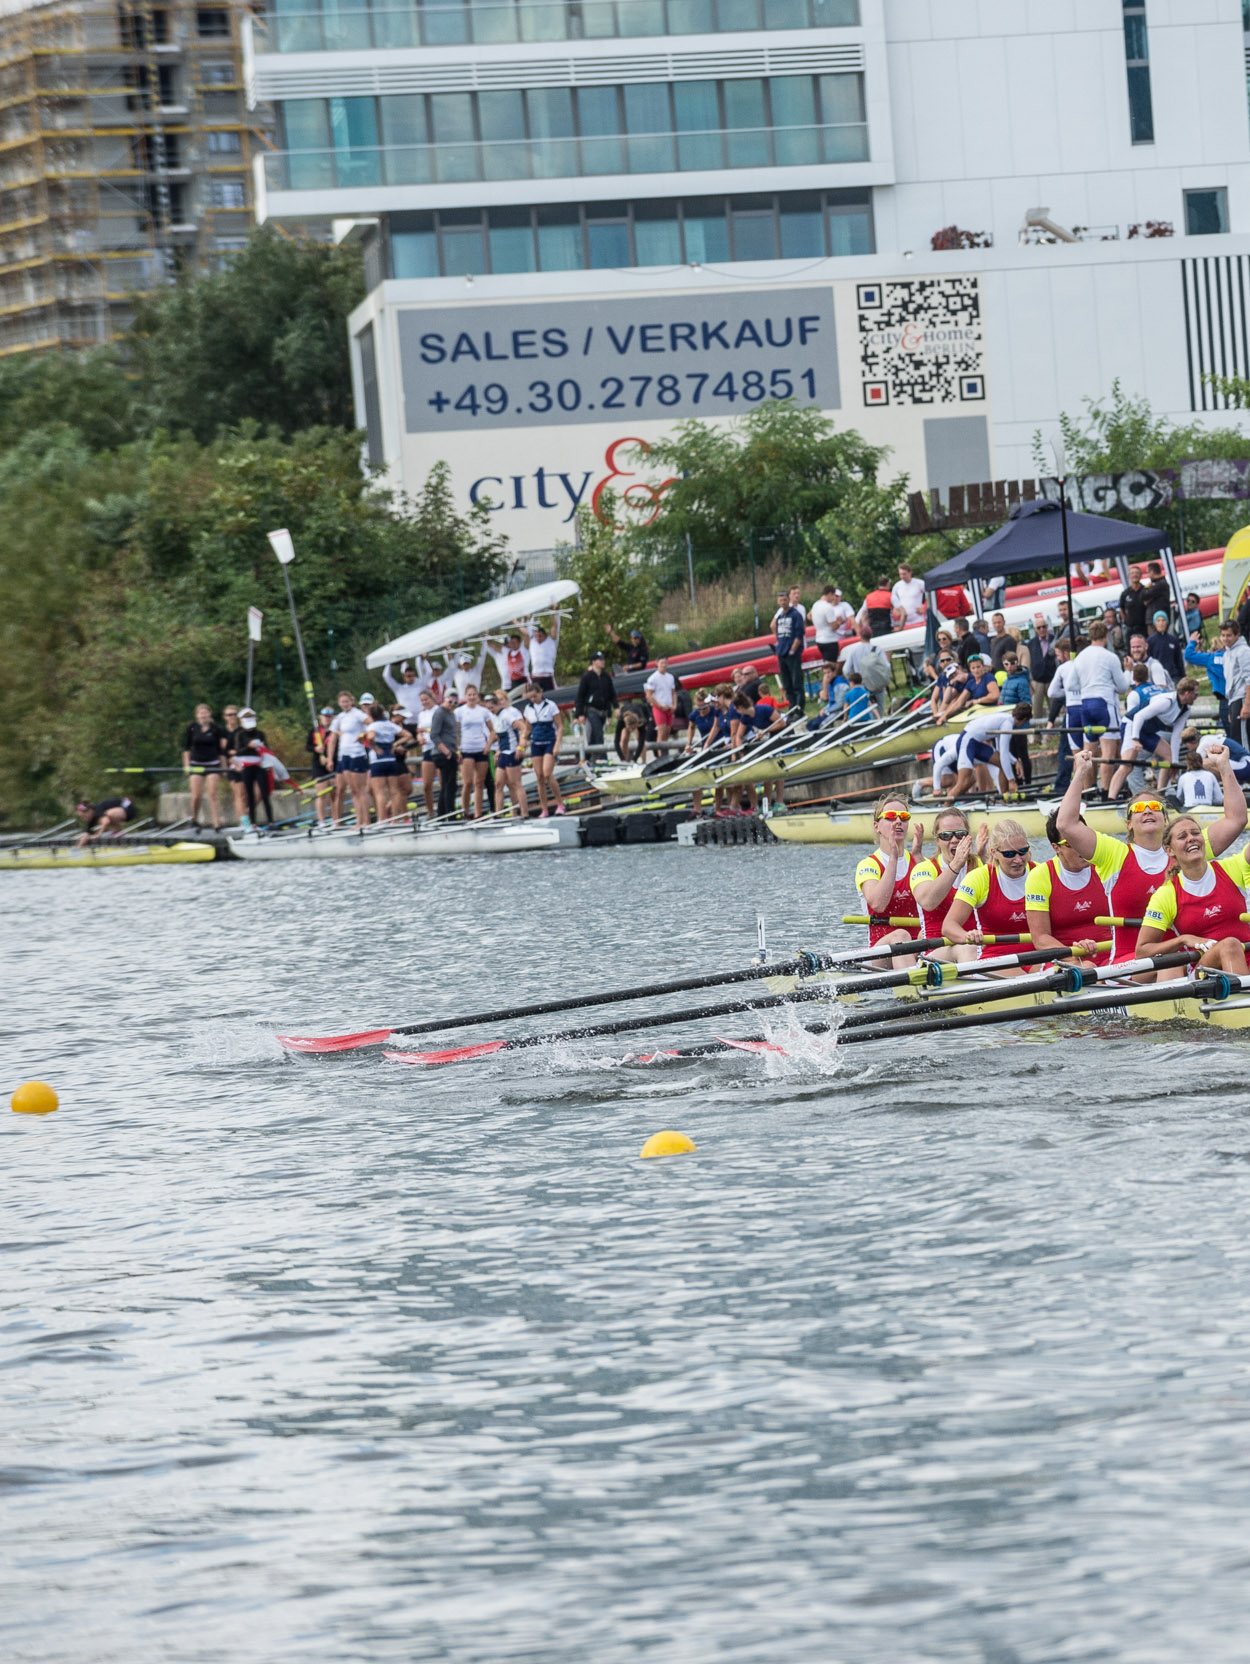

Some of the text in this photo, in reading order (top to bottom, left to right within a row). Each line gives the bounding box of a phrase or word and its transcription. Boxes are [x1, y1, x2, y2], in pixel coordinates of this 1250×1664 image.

[419, 315, 821, 365] SALES / VERKAUF
[870, 332, 902, 348] city
[427, 366, 819, 418] +49.30.27874851
